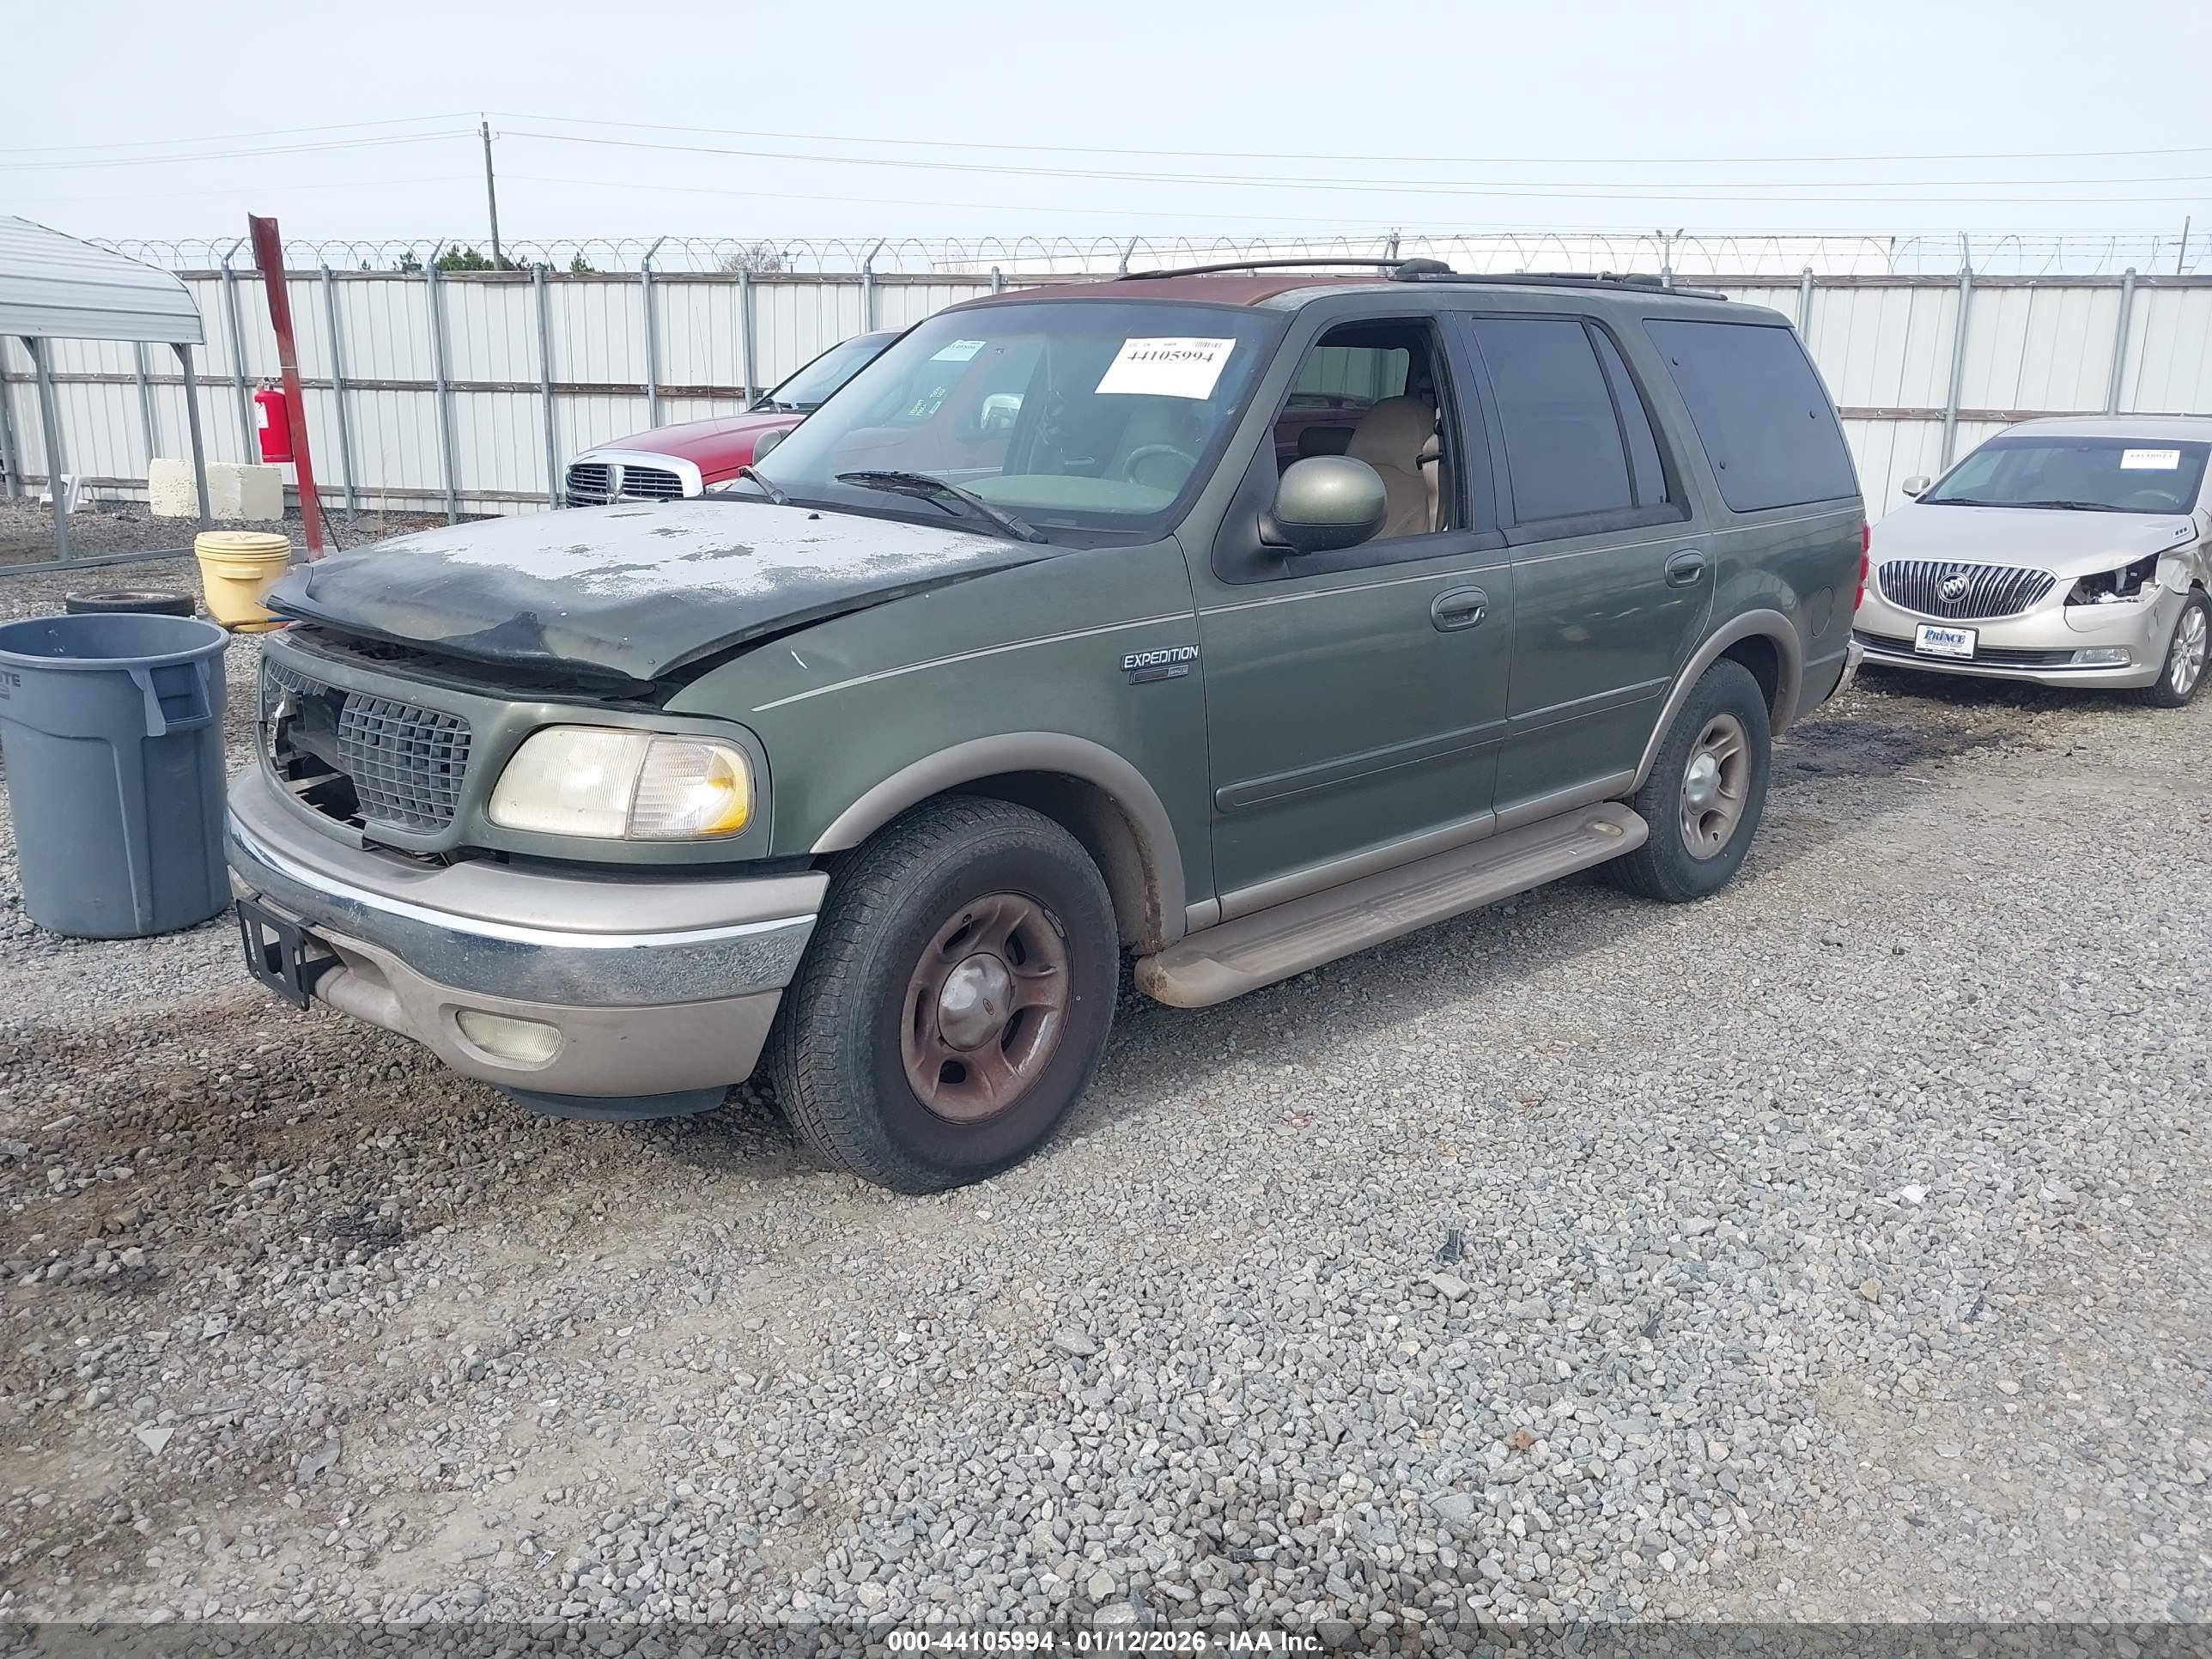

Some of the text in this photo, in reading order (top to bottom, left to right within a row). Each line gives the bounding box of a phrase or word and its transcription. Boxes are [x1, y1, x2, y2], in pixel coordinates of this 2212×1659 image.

[1127, 351, 1214, 362] 44105994
[1924, 629, 1966, 643] PRINCE
[1124, 646, 1199, 668] EXPEDITION
